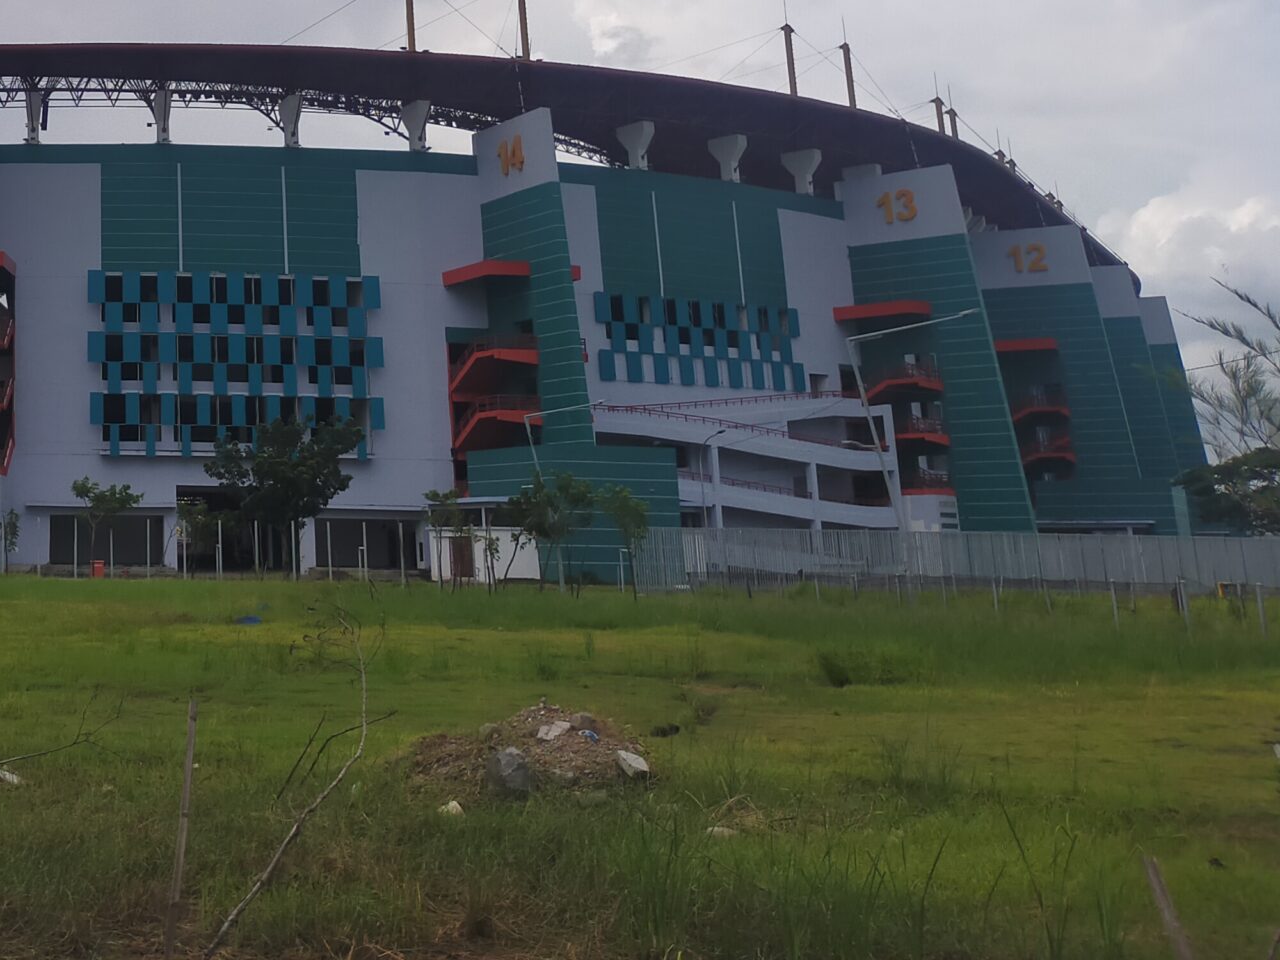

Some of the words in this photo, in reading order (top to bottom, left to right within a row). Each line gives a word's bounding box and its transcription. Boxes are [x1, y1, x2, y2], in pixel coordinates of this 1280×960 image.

[497, 134, 524, 177] 14
[876, 189, 918, 225] 13
[1007, 243, 1048, 273] 12
